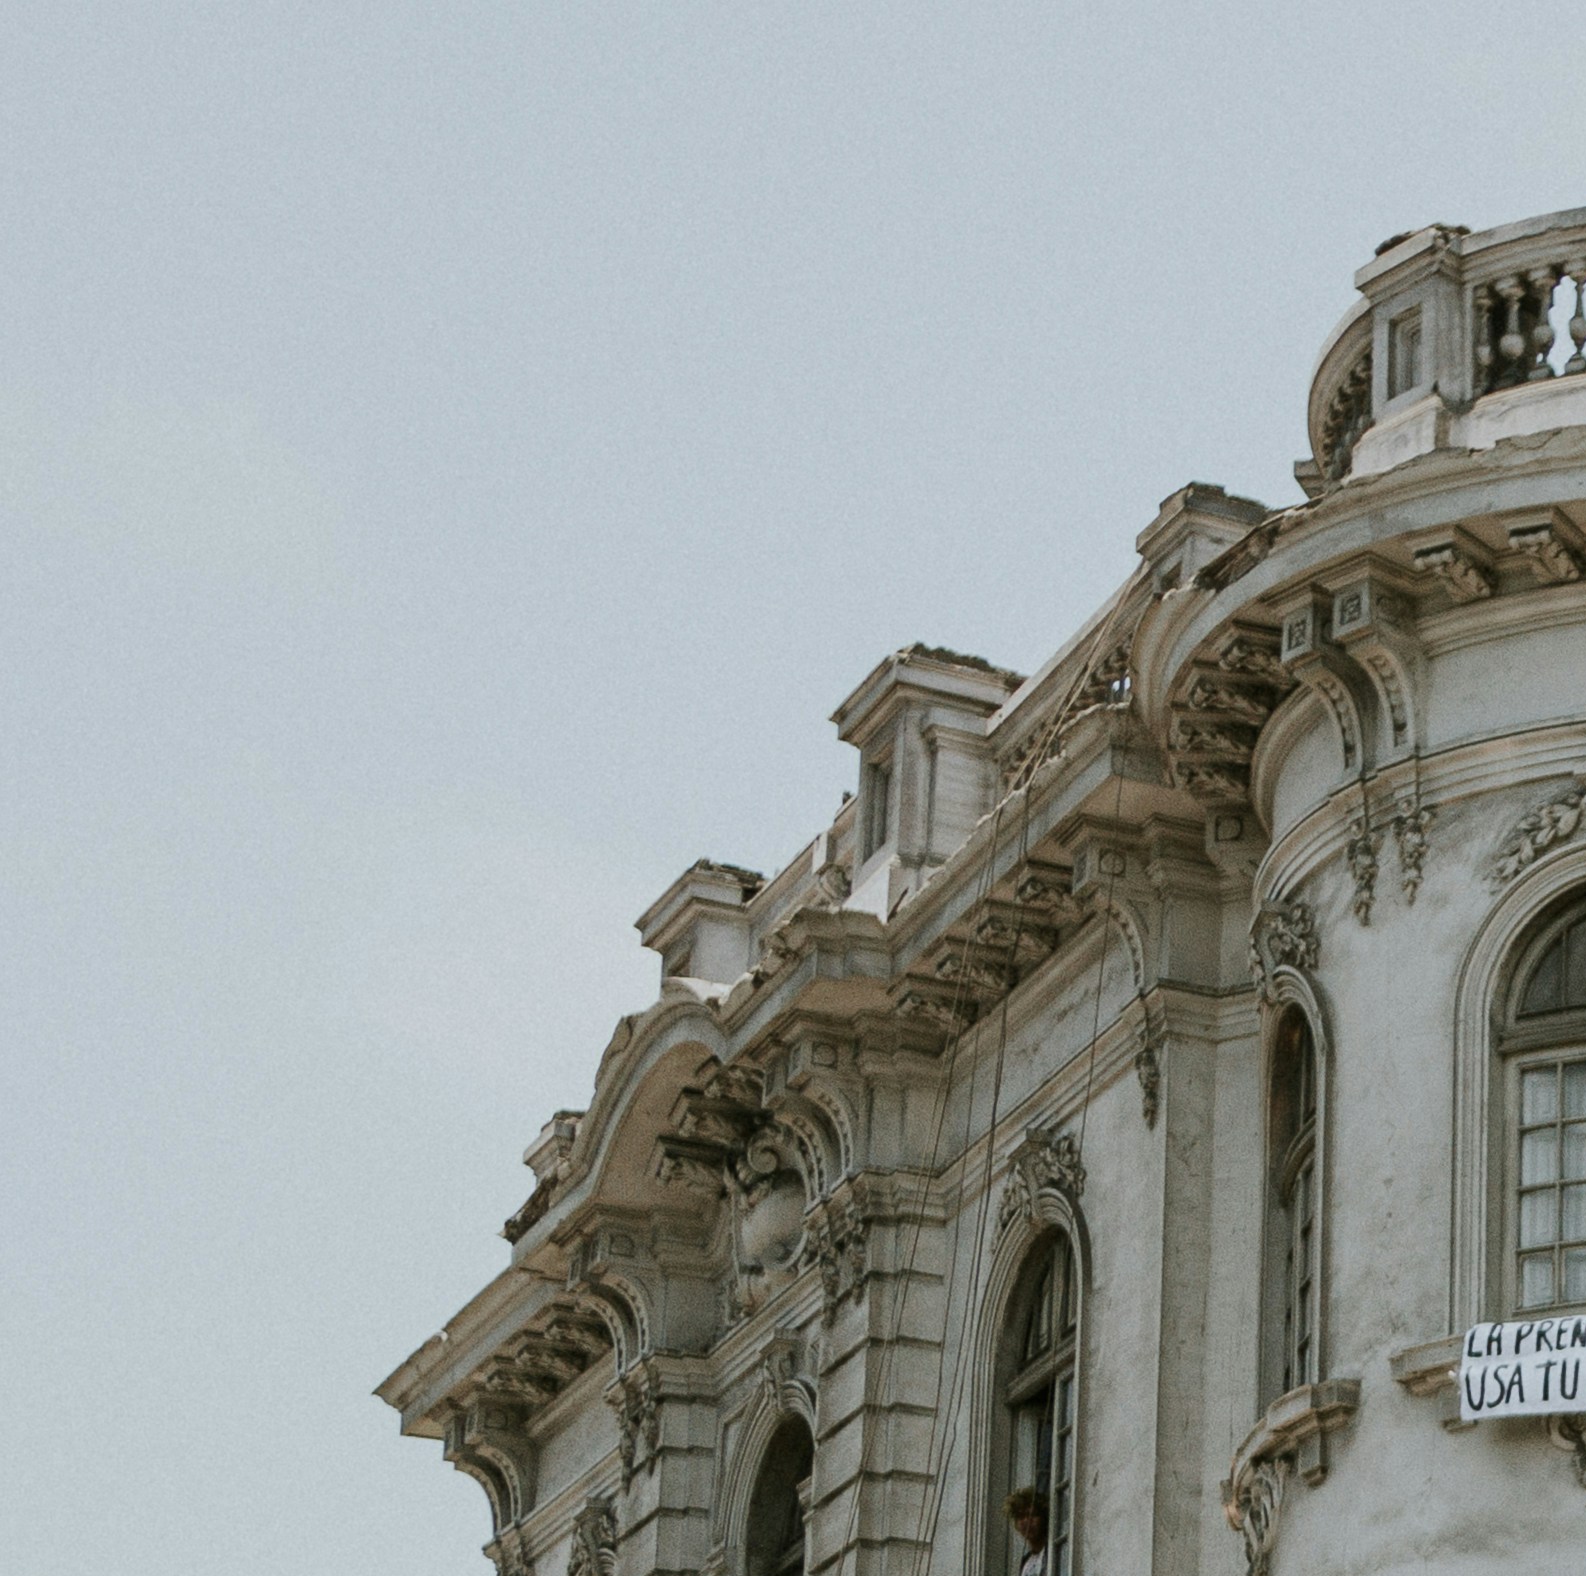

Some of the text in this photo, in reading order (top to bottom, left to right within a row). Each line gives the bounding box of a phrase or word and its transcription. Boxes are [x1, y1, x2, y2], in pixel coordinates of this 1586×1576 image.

[1466, 1322, 1504, 1357] LA
[1465, 1364, 1524, 1411] USA
[1536, 1357, 1580, 1401] TU
